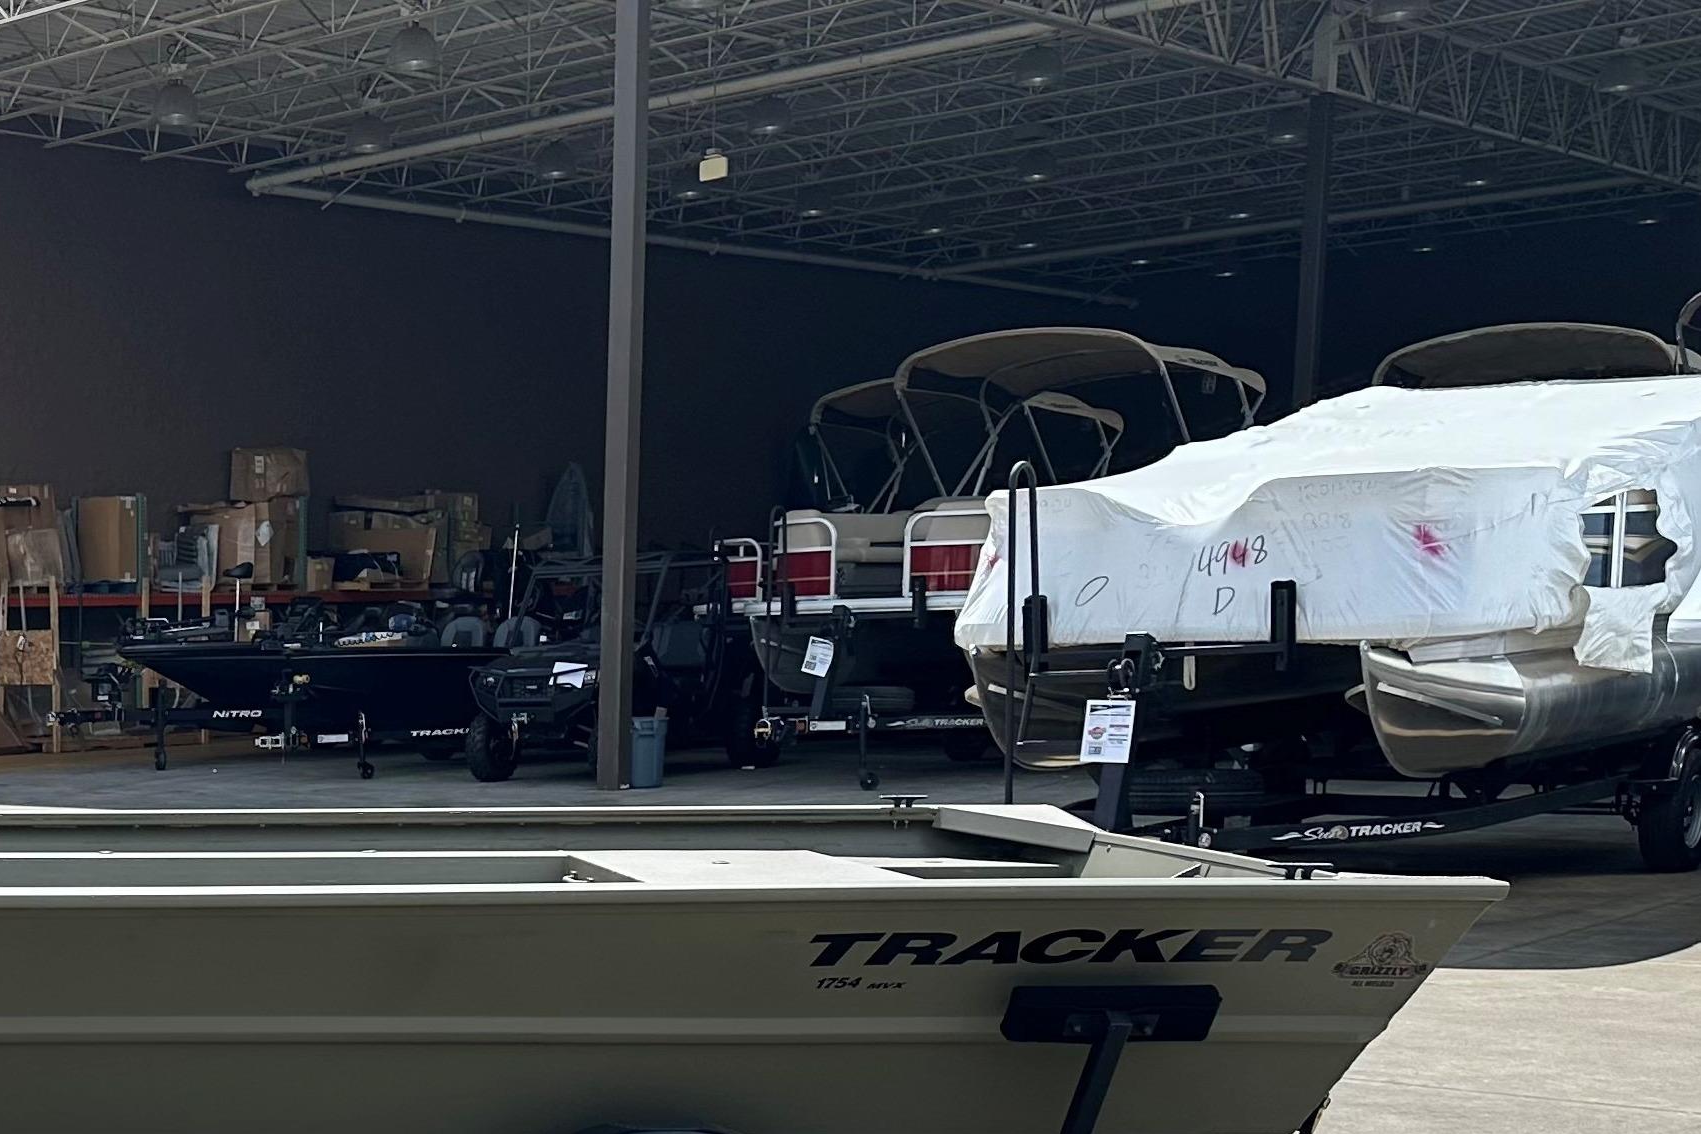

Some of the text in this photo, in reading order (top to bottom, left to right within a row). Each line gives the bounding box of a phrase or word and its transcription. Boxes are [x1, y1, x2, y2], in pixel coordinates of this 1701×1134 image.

[1198, 535, 1269, 577] 4948
[1212, 586, 1236, 616] D
[934, 718, 984, 726] TRACKER
[1349, 821, 1422, 838] TRACKER
[808, 928, 1333, 968] TRACKER
[1349, 966, 1409, 976] GRIZZLY
[815, 977, 907, 990] 1754 MVX
